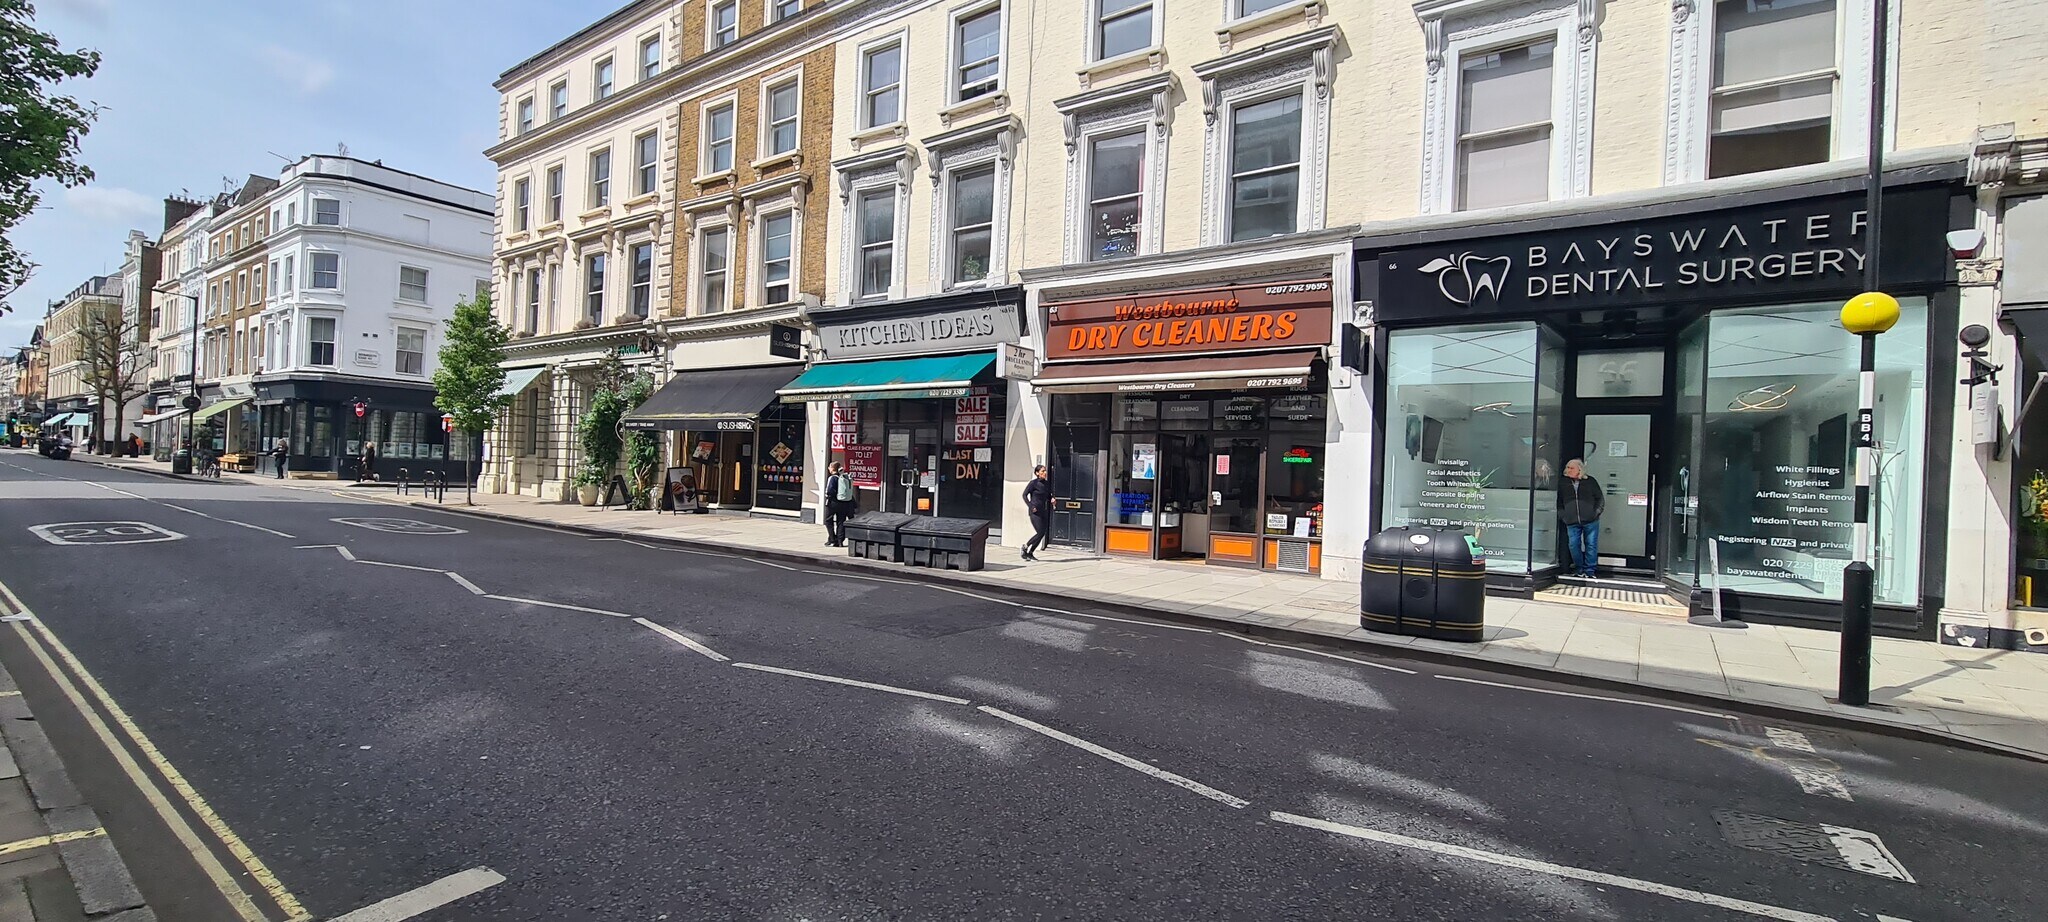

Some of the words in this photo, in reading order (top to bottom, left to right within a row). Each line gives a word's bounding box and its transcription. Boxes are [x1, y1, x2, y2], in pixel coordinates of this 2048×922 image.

[1528, 210, 1867, 268] BAYSWATER
[1527, 268, 1664, 298] DENTAL
[1677, 246, 1867, 286] SURGERY
[1265, 286, 1288, 294] 0207
[1288, 284, 1305, 293] 792
[1305, 282, 1328, 291] 9695
[1049, 306, 1058, 314] 63
[1115, 298, 1239, 321] Westbourne
[838, 321, 925, 349] KITCHEN
[929, 314, 994, 341] IDEAS
[1068, 324, 1127, 351] DRY
[1131, 311, 1298, 347] CLEANERS
[1013, 348, 1018, 357] 2
[1018, 349, 1026, 359] hr
[1118, 383, 1154, 391] Westbourne
[1167, 381, 1196, 389] Cleaners
[1247, 379, 1266, 387] 0207
[1267, 378, 1282, 386] 792
[1282, 377, 1303, 385] 9695
[957, 397, 986, 413] SALE
[833, 409, 857, 423] SALE
[956, 425, 986, 441] SALE
[832, 434, 856, 448] SALE
[949, 450, 972, 461] LAST
[1438, 459, 1469, 467] Invisalign
[956, 463, 981, 479] DAY
[1775, 465, 1804, 473] White
[1806, 466, 1840, 475] Fillings
[1446, 480, 1481, 489] Whitening
[1784, 479, 1830, 488] Hygienist
[1421, 490, 1456, 498] Composite
[1457, 491, 1486, 500] Bonding
[1756, 490, 1790, 499] Airflow
[1791, 492, 1816, 500] Stain
[1786, 505, 1829, 513] Implants
[1463, 520, 1486, 529] private
[1487, 522, 1515, 530] patients
[1751, 516, 1790, 526] Wisdom
[1791, 518, 1819, 527] Teeth
[1821, 520, 1854, 528] Remov
[53, 526, 155, 539] 20
[1718, 534, 1768, 546] Registering
[1770, 537, 1797, 548] NHS
[1799, 540, 1818, 548] and
[1762, 558, 1784, 567] 020
